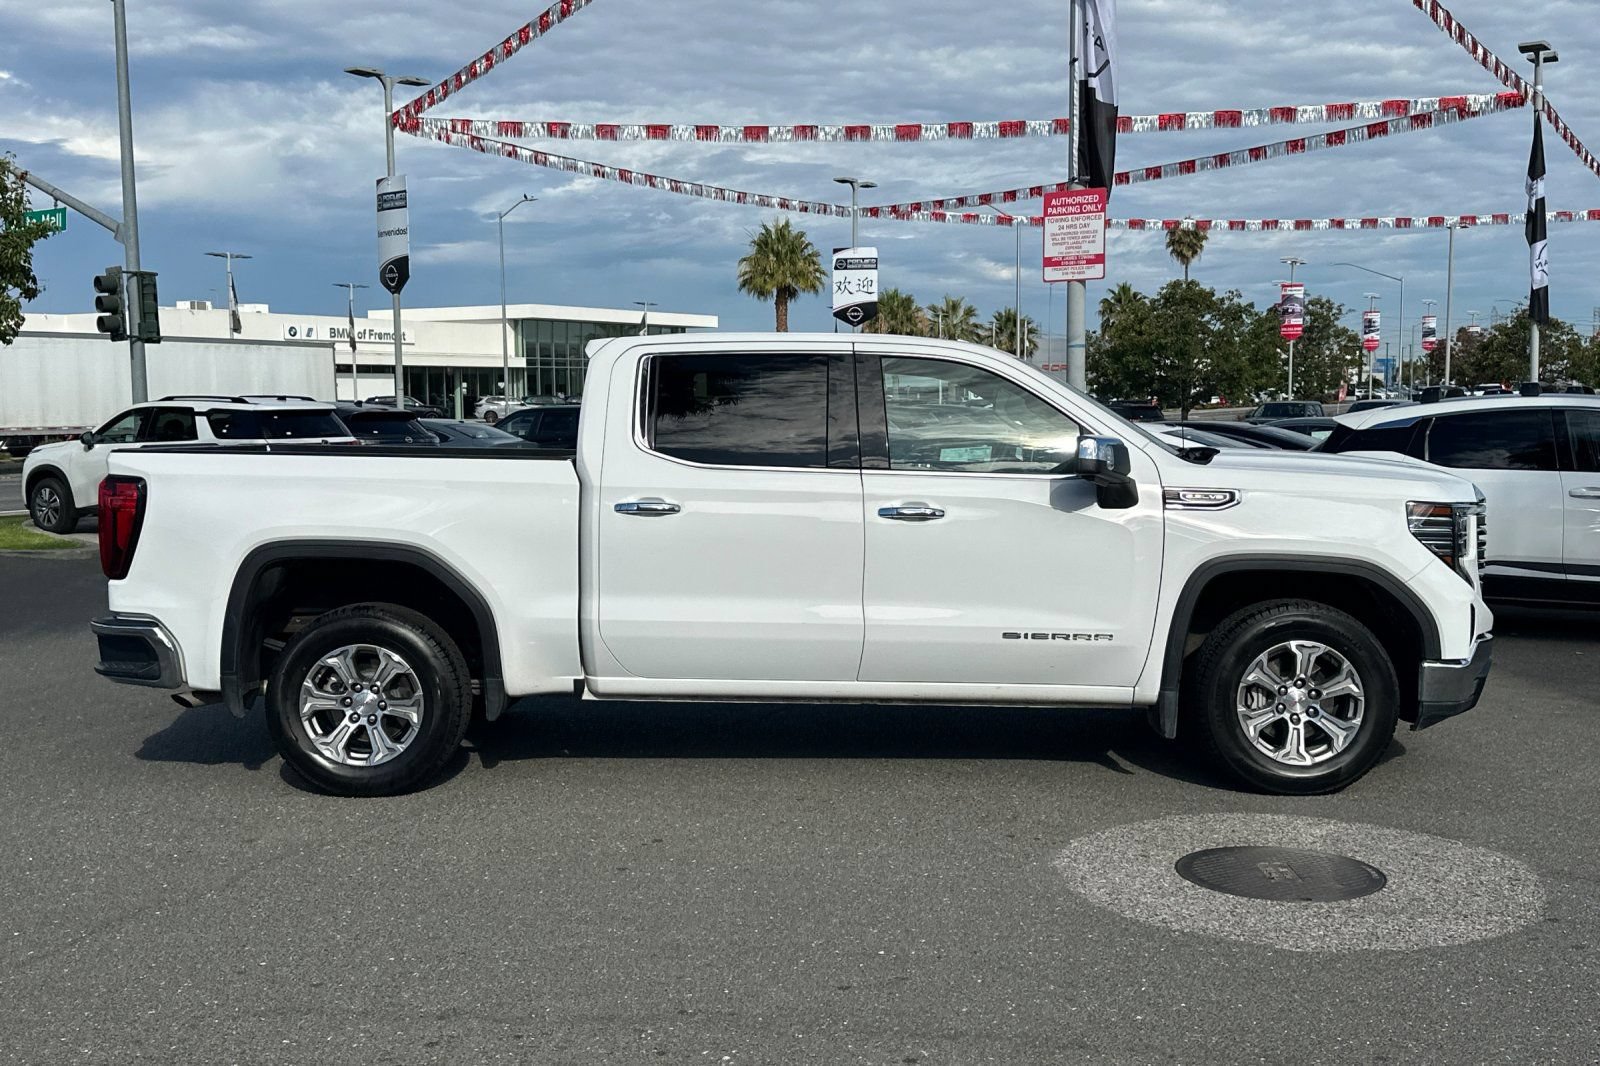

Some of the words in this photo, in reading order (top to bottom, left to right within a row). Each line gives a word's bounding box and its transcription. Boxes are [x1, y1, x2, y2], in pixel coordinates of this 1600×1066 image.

[1051, 194, 1099, 206] AUTHORIZED
[1047, 205, 1081, 215] PARKING
[1082, 203, 1102, 212] ONLY
[41, 212, 62, 227] Mall
[1071, 214, 1102, 222] ENFORCED
[834, 275, 876, 295] 欢迎
[357, 328, 367, 339] of
[368, 329, 406, 341] Fremot
[1002, 632, 1114, 641] SIERRA
